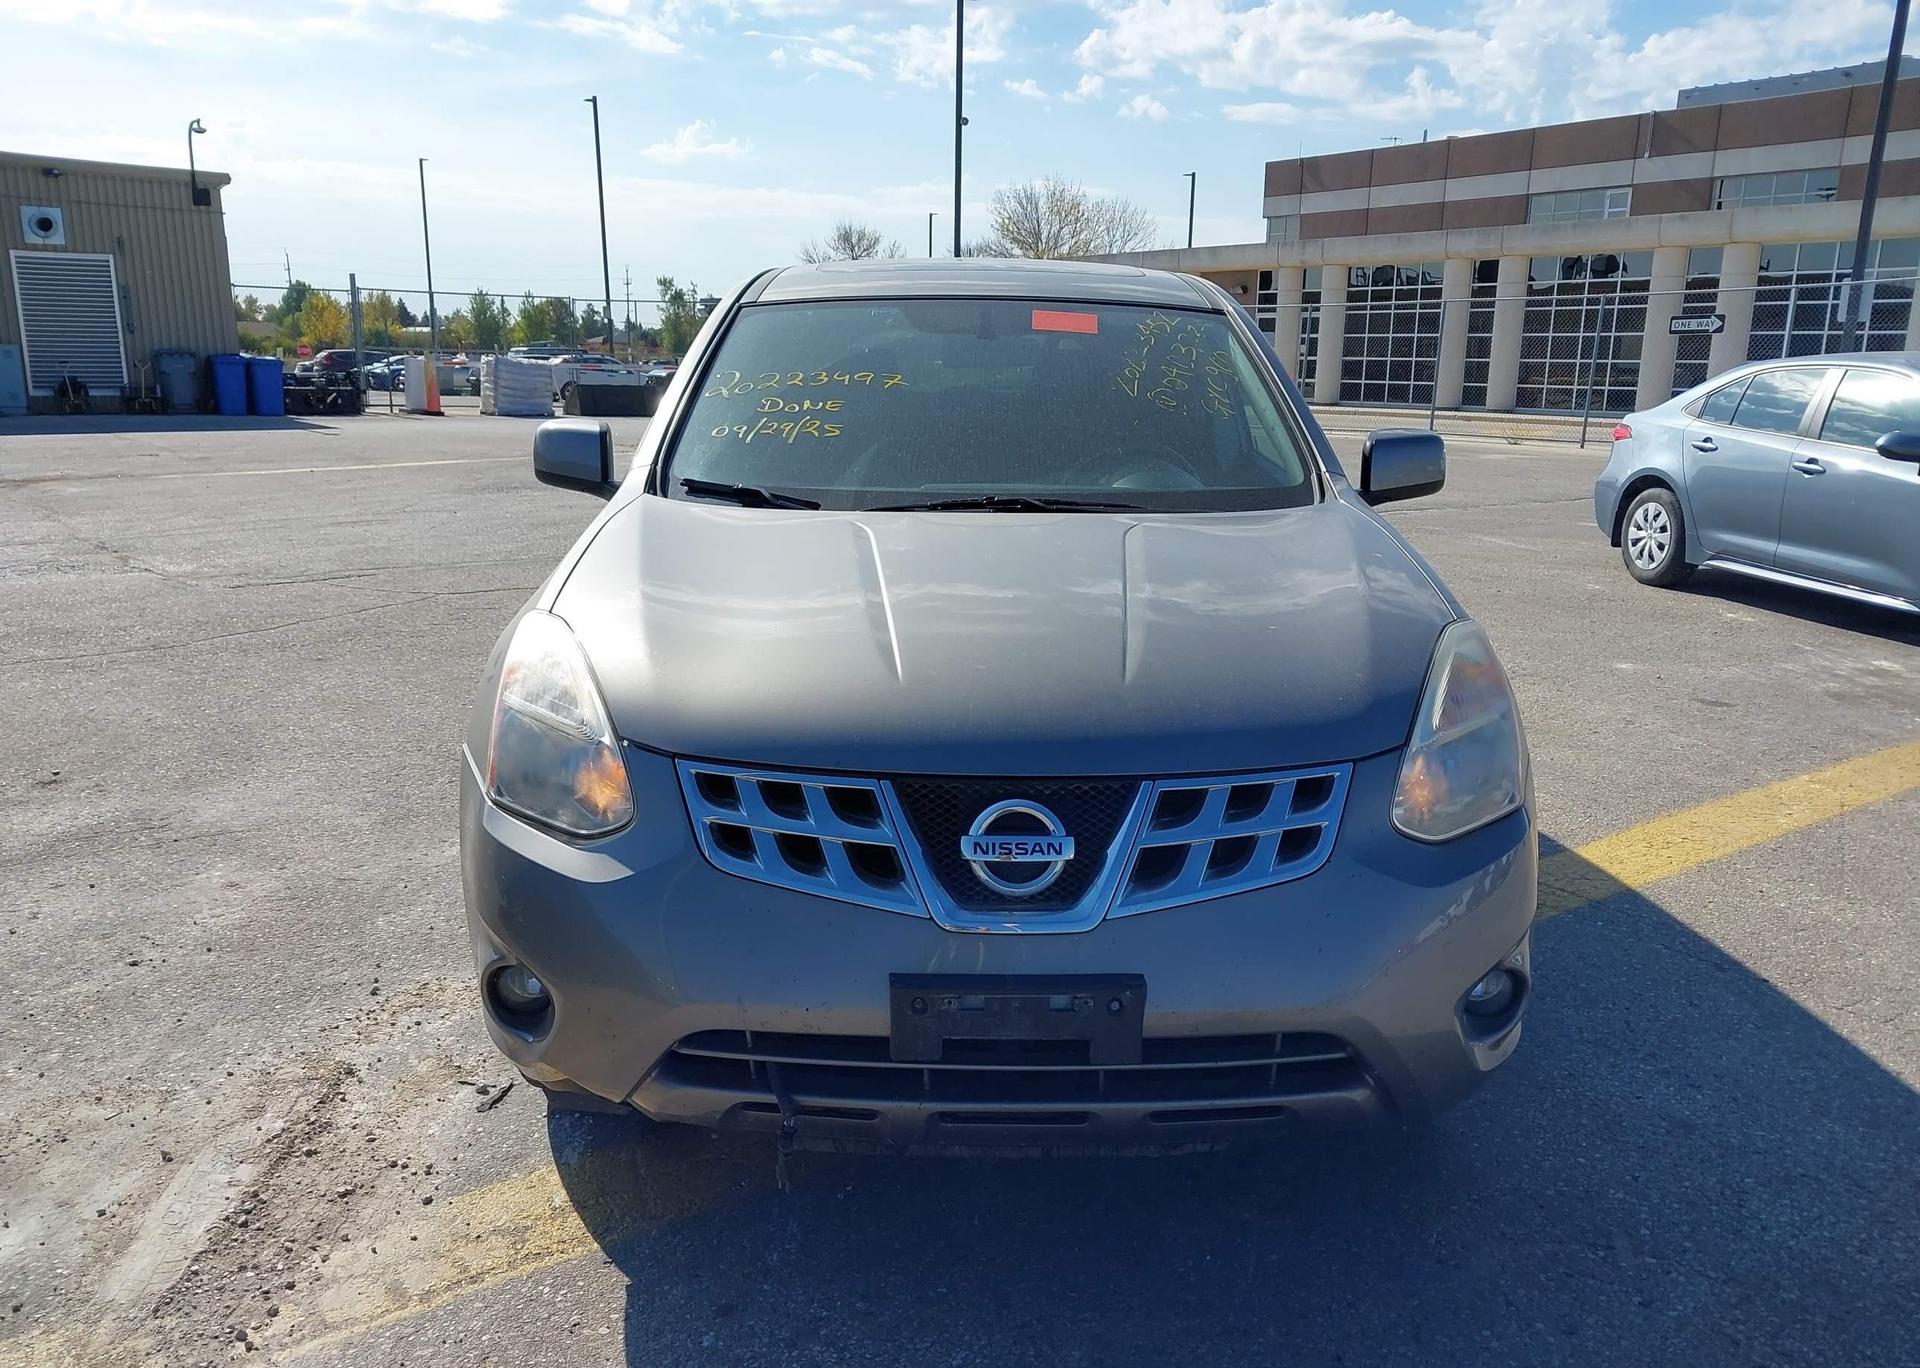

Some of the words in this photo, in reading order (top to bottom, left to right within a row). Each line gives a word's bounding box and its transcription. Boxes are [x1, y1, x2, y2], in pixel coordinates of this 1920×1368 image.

[1696, 320, 1715, 328] WAY
[705, 370, 909, 399] 20223497
[711, 416, 844, 444] 09/29/25
[973, 841, 1063, 856] NISSAN
